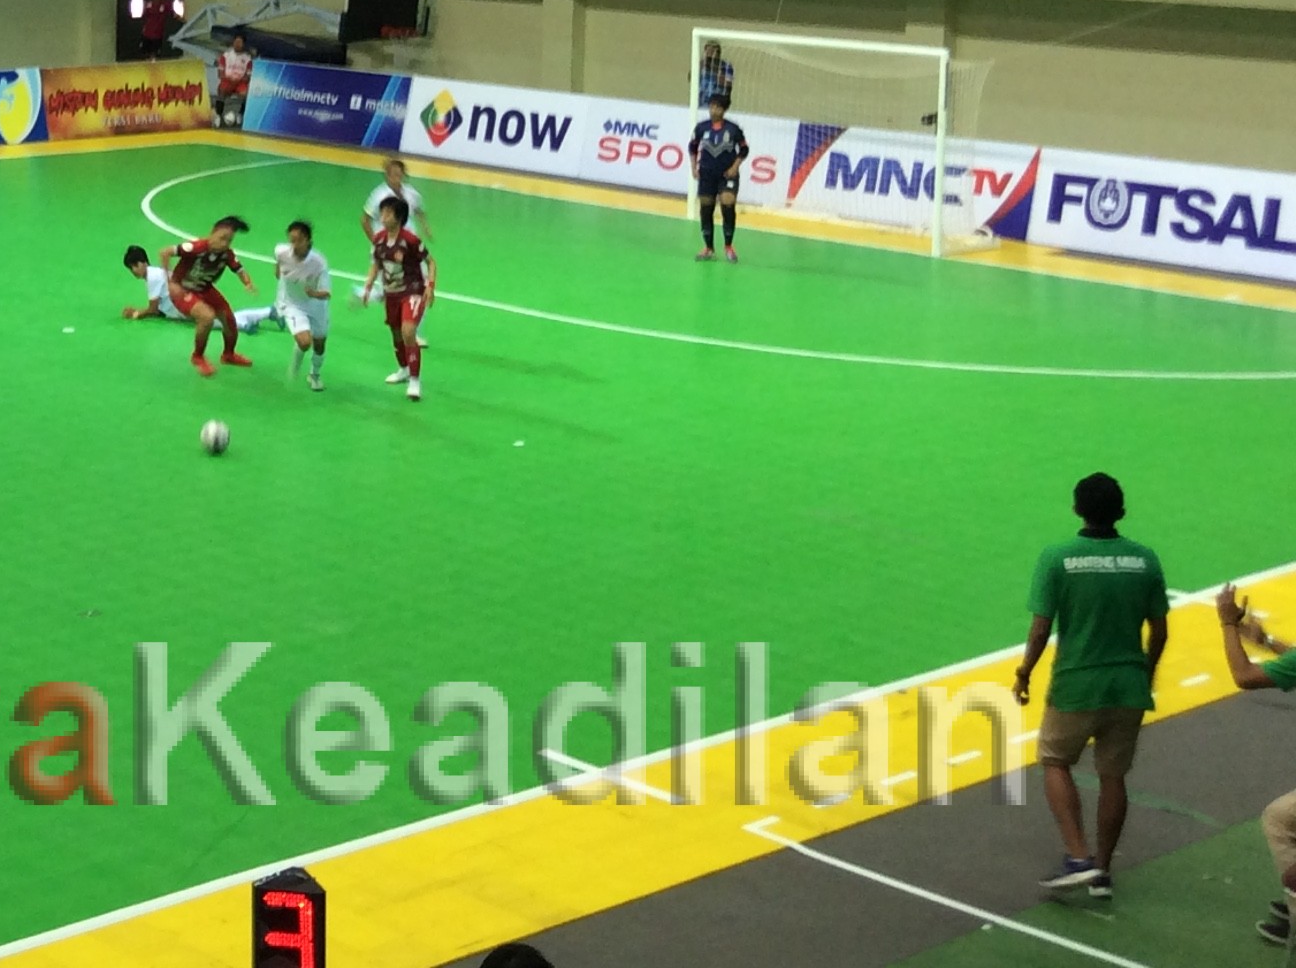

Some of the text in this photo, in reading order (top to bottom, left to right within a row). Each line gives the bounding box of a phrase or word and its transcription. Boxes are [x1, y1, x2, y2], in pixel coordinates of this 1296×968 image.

[467, 101, 572, 153] now
[612, 119, 659, 140] MNC
[597, 136, 777, 184] SPOS
[1045, 172, 1296, 253] FUTSAL
